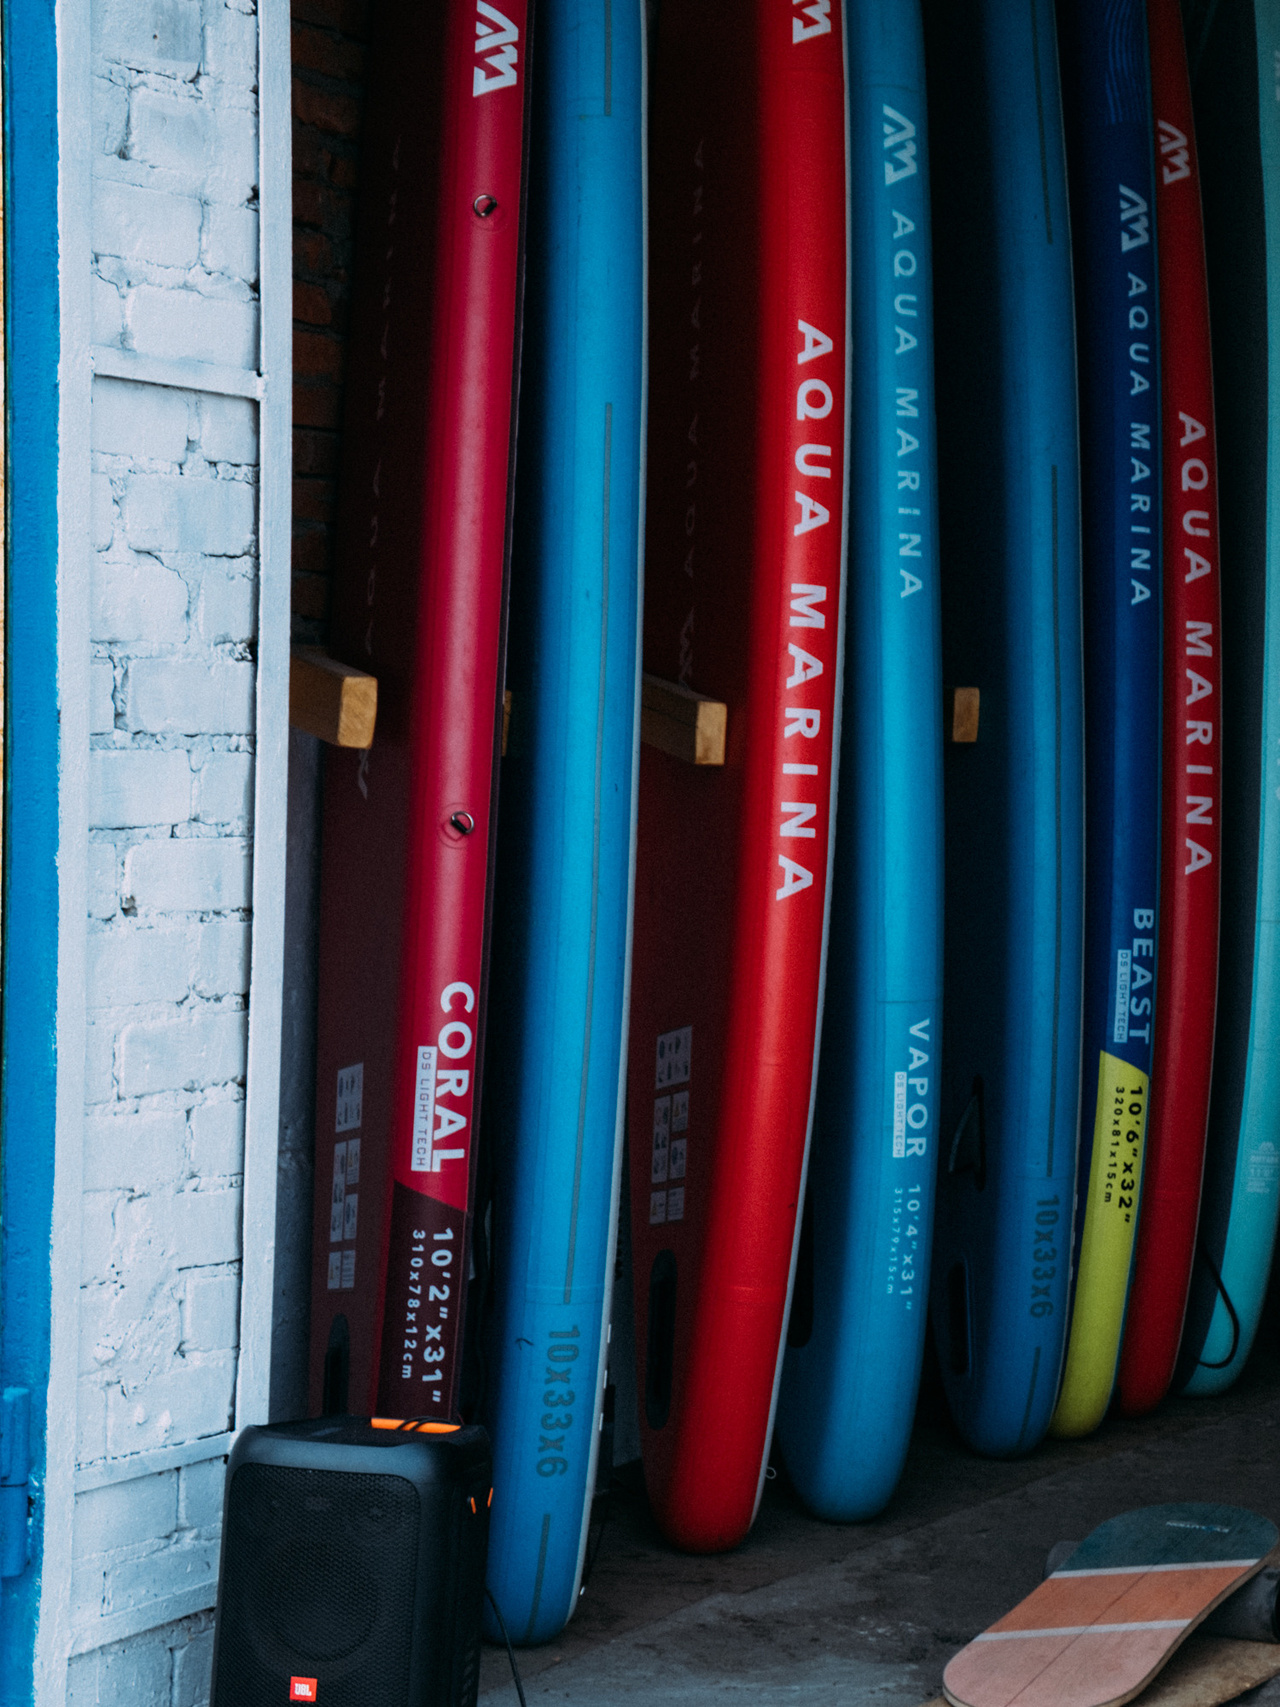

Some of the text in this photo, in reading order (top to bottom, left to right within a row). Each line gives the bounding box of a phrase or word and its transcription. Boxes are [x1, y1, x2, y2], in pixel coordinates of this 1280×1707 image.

[891, 208, 918, 355] AQUA
[1126, 271, 1150, 396] AQUA
[895, 386, 924, 598] MARINA
[1130, 421, 1151, 606] MARINA
[1178, 410, 1212, 584] AQUA
[775, 319, 834, 901] AQUA MARINA
[1184, 620, 1213, 875] MARINA
[1117, 951, 1129, 1040] DS LIGHT TECH
[1129, 907, 1155, 1045] BEAST
[416, 1050, 432, 1167] DS LIGHT TECH
[431, 981, 475, 1173] CORAL
[906, 1018, 931, 1158] VAPOR
[1030, 1193, 1060, 1319] 10x33x6
[536, 1324, 580, 1478] 10x33x6
[294, 1682, 312, 1697] JBL
